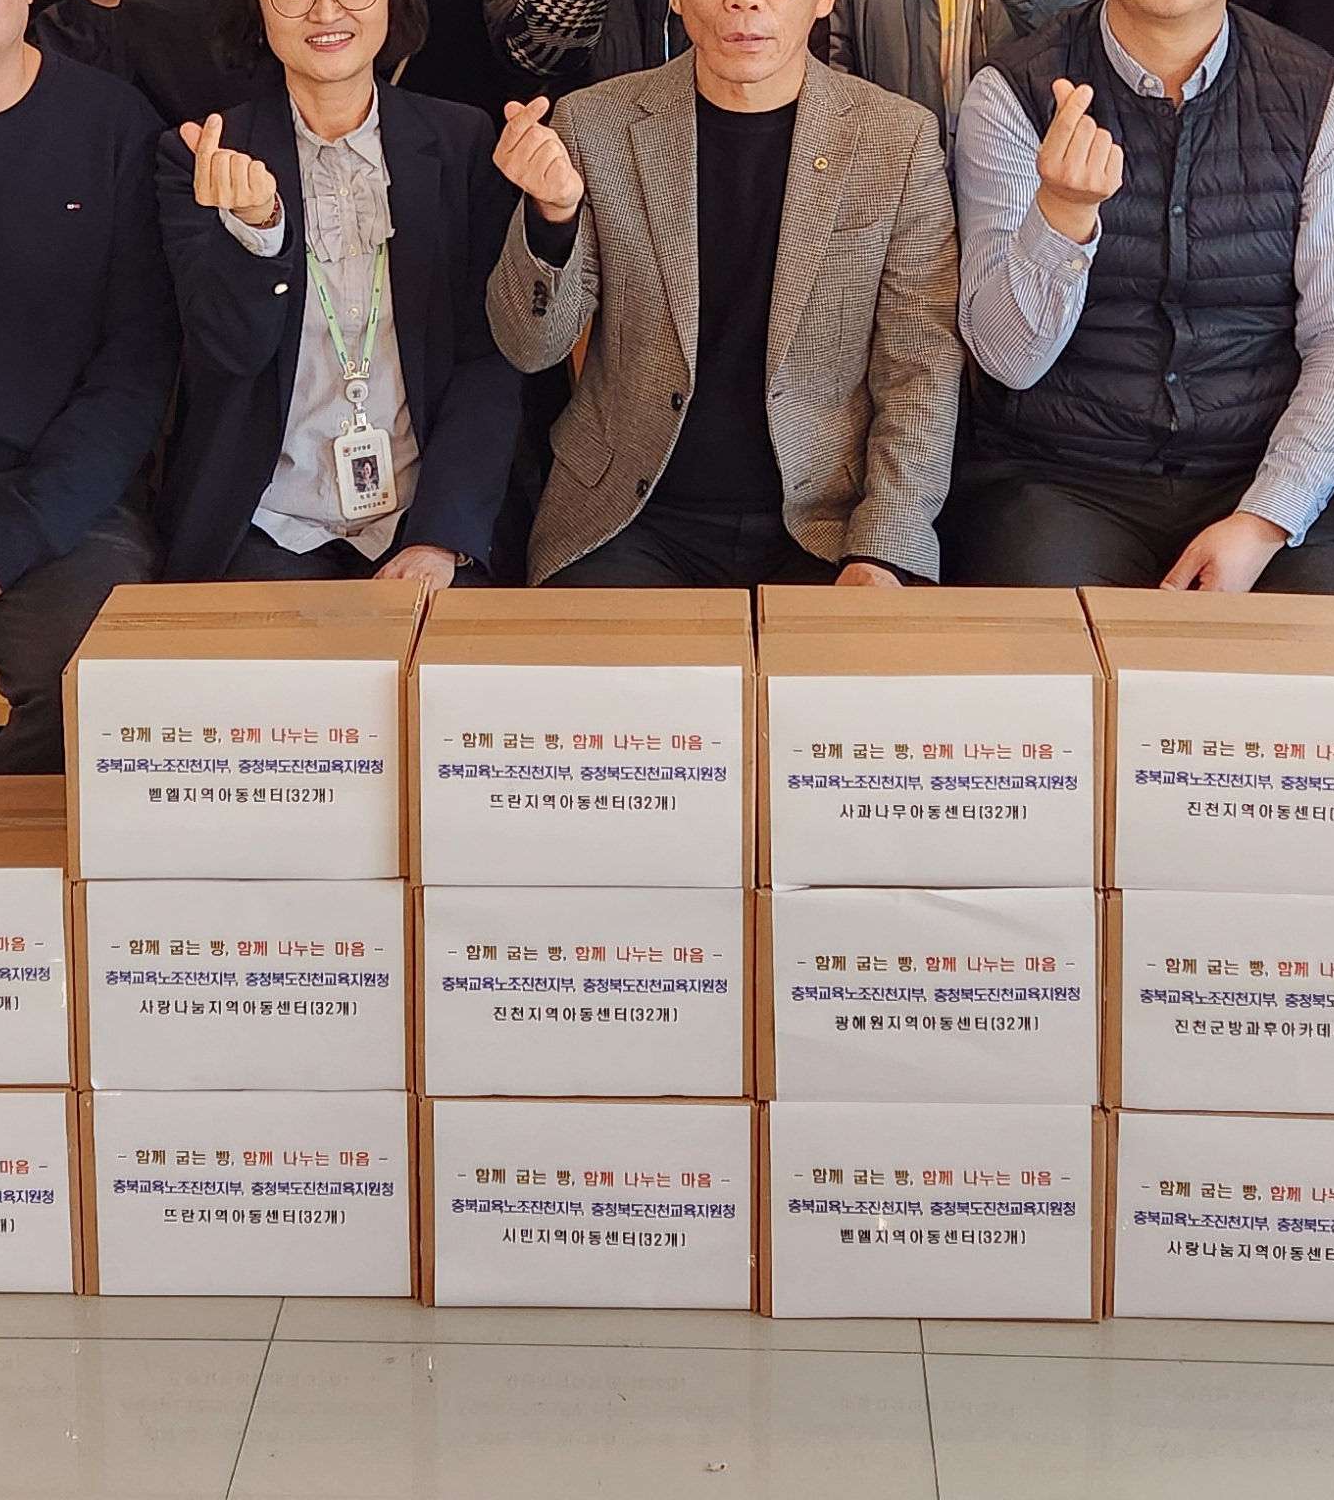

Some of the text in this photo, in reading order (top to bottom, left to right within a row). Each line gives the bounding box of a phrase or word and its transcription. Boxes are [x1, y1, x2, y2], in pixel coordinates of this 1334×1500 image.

[120, 726, 360, 744] 함께 굽는 빵, 함께 나누는 마음
[461, 732, 703, 751] 함께 굽는 빵, 함께 나누는 마음
[811, 742, 1054, 760] 함께 굽는 빵, 함께 나누는 마음
[1160, 738, 1193, 756] 함께
[1202, 739, 1235, 757] 굽는
[1244, 741, 1265, 759] 빵,
[1273, 743, 1306, 760] 함께
[96, 758, 385, 775] 충북교육노조진천지부, 충청북도진천교육지원청
[437, 763, 727, 782] 충북교육노조진천지부, 충청북도진천교육지원청
[787, 774, 1078, 791] 충북교육노조진천지부, 충청북도진천교육지원청
[1134, 769, 1274, 790] 충북교육노조진천지부,
[129, 938, 366, 958] 함께 굽는 빵, 함께 나누는 마음
[465, 944, 704, 964] 함께 굽는 빵, 함께 나누는 마음
[815, 955, 1056, 973] 함께 굽는 빵, 함께 나누는 마음
[1165, 957, 1198, 975] 함께
[1207, 959, 1240, 976] 굽는
[1248, 960, 1269, 977] 빵,
[1277, 961, 1309, 978] 함께
[105, 970, 390, 988] 충북교육노조진천지부, 충청북도진천교육지원청
[441, 976, 728, 994] 충북교육노조진천지부, 충청북도진천교육지원청
[791, 985, 1081, 1003] 충북교육노조진천지부, 충청북도진천교육지원청
[1139, 988, 1278, 1008] 충북교육노조진천지부,
[0, 1159, 30, 1176] 마음
[475, 1167, 712, 1189] 함께 굽는 빵, 함께 나누는 마음
[1159, 1179, 1191, 1198] 함께
[1200, 1182, 1233, 1200] 굽는
[1242, 1184, 1262, 1201] 빵,
[1270, 1185, 1302, 1203] 함께
[451, 1198, 736, 1219] 충북교육노조진천지부, 충청북도진천교육지원청
[1133, 1210, 1270, 1232] 충북교육노조진천지부,
